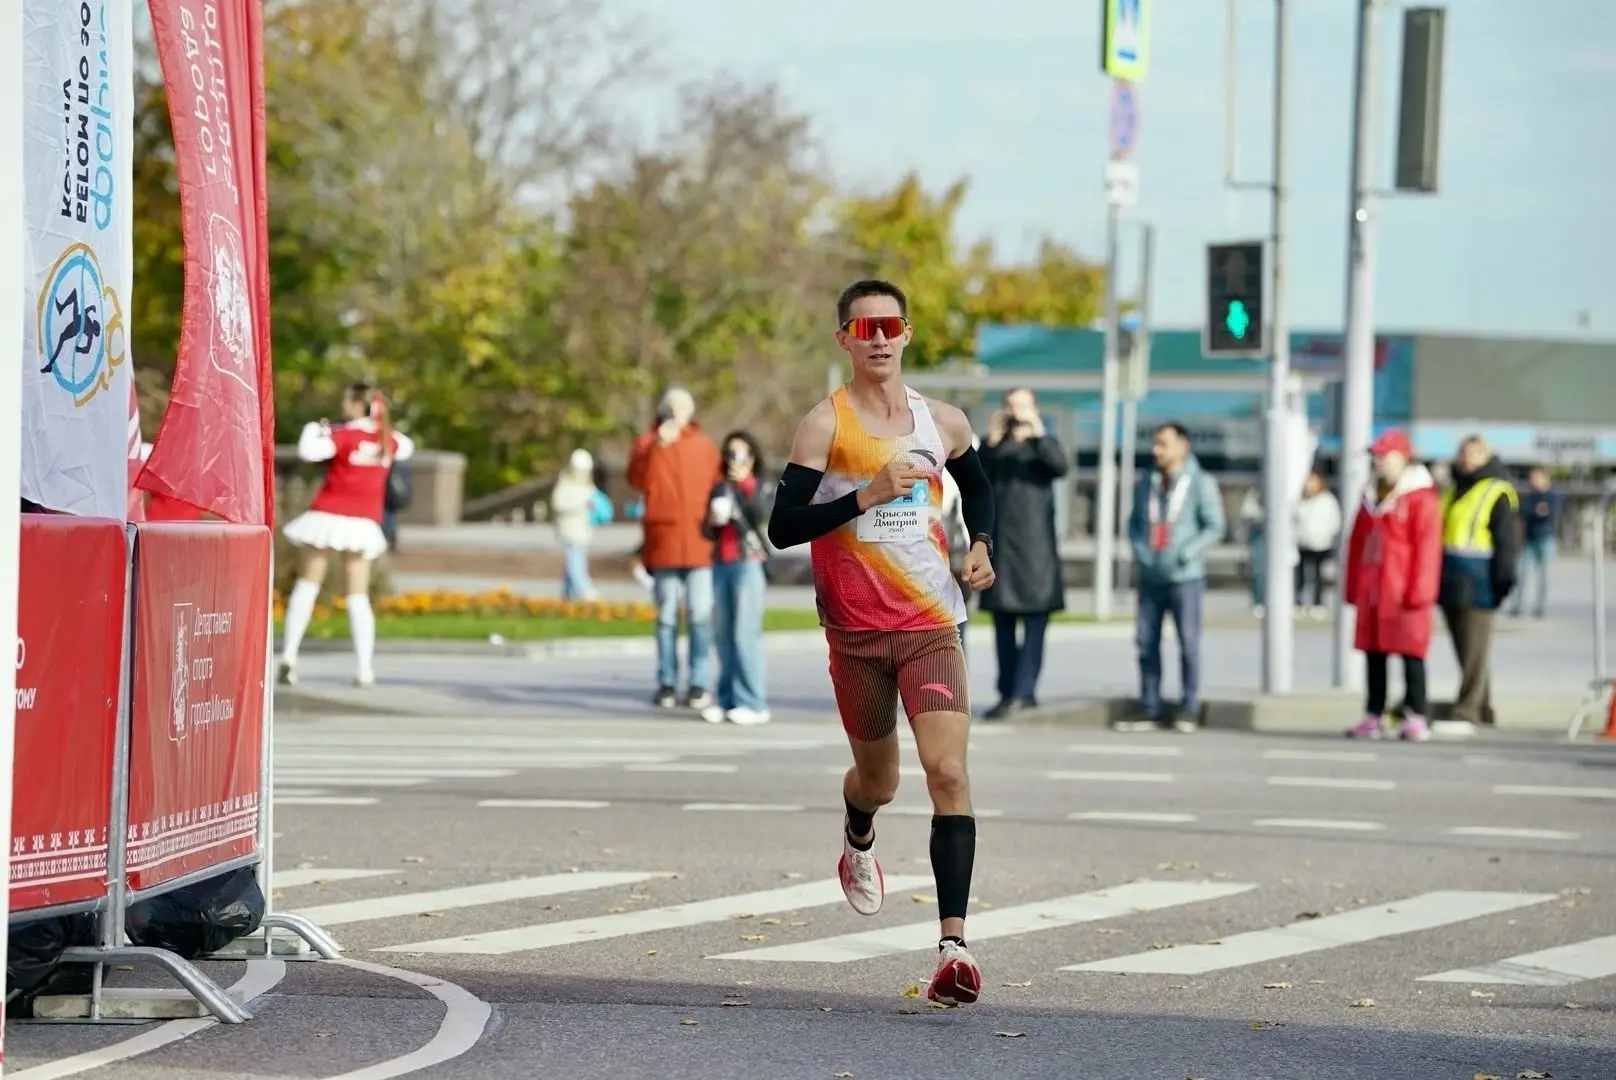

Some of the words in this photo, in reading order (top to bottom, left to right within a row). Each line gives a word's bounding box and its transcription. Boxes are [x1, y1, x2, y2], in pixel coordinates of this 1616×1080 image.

[875, 509, 917, 519] Крыслов
[873, 518, 918, 528] Дмитрий
[15, 687, 37, 710] ОМУ
